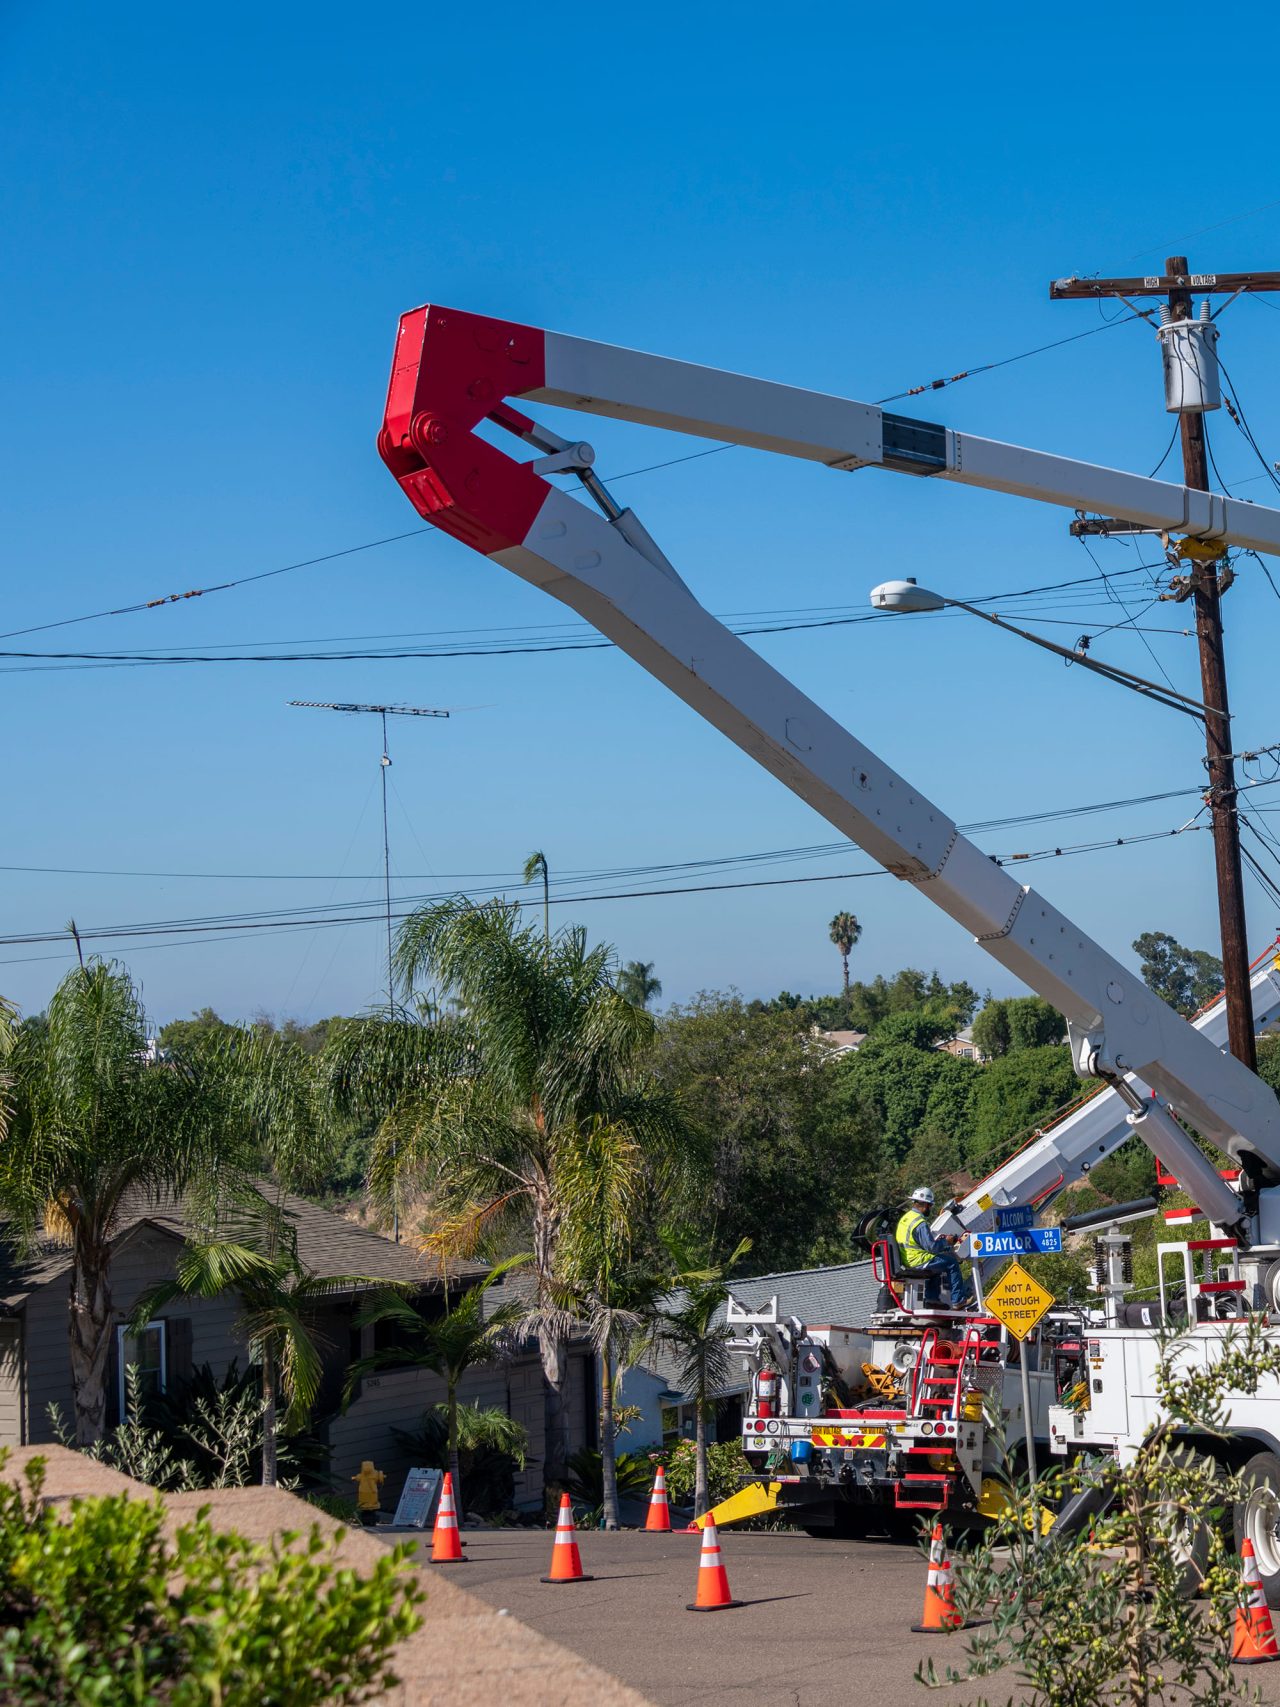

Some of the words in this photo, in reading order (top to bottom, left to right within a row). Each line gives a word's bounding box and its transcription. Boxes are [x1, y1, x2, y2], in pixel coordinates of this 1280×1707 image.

[1193, 275, 1215, 285] VOLTAGE
[1002, 1211, 1024, 1228] ALCORN
[985, 1236, 1032, 1252] BAYLOR
[1005, 1284, 1022, 1293] NOT
[997, 1296, 1040, 1306] THROUGH
[1002, 1310, 1038, 1320] STREET
